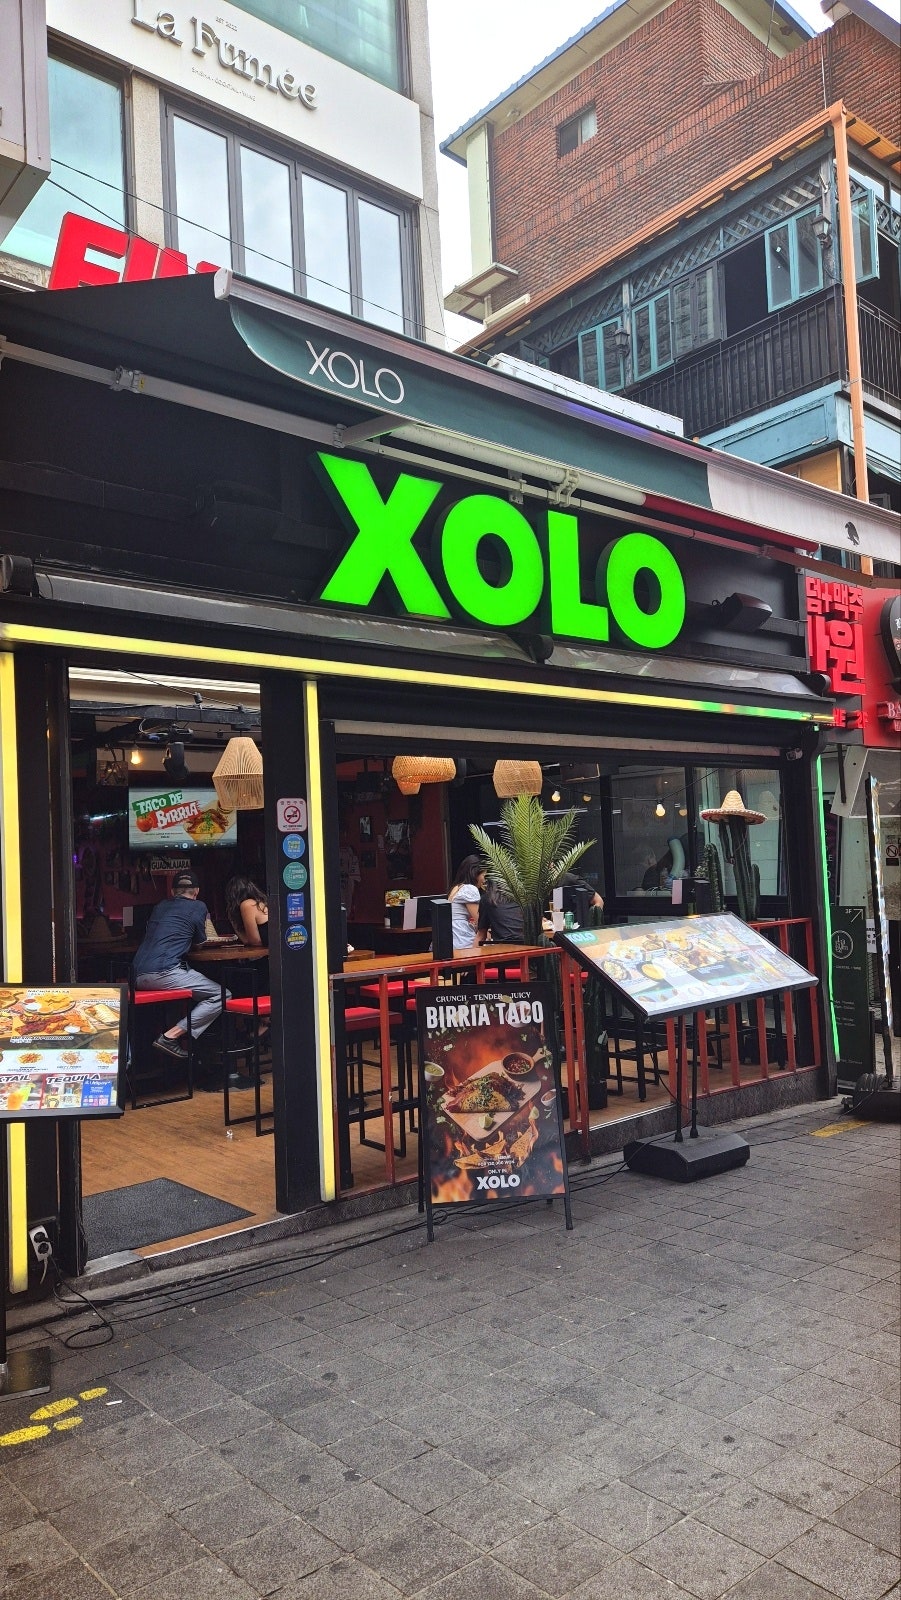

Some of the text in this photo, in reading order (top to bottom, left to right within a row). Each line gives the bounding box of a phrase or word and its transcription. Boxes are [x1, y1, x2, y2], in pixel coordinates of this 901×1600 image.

[130, 0, 319, 110] La Fumée
[306, 340, 405, 404] XOLO
[315, 451, 686, 649] XOLO
[136, 792, 183, 814] TACO DE
[156, 802, 198, 827] BIRRIA
[473, 993, 503, 1001] TENDER
[510, 991, 532, 999] JUICY
[426, 1000, 544, 1029] BIRRIA TACO
[47, 1074, 100, 1084] TEQUILA
[476, 1174, 521, 1190] XOLO
